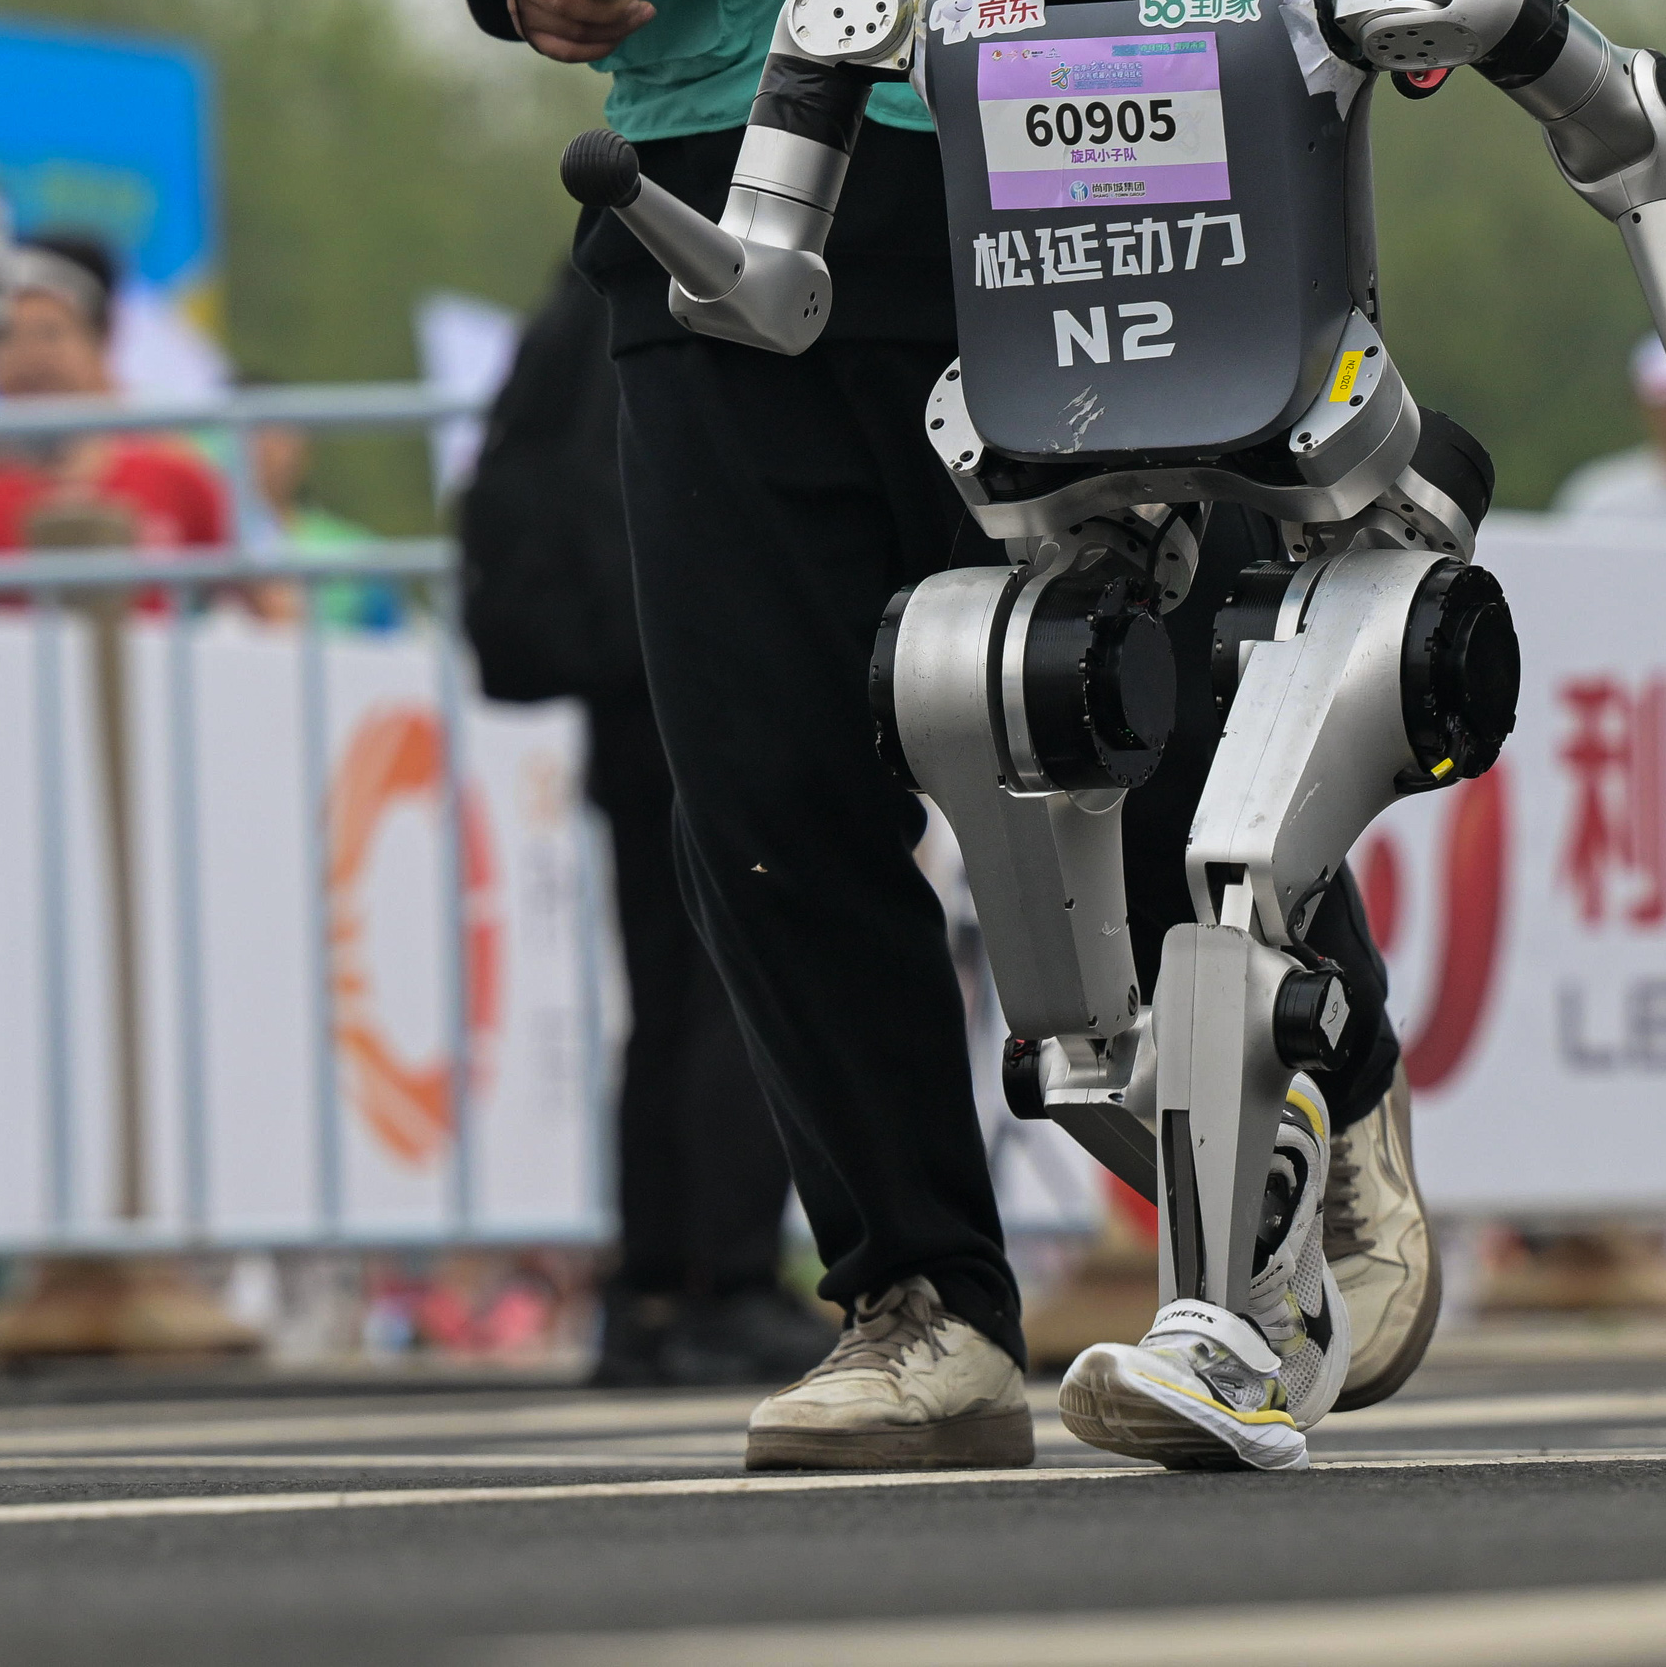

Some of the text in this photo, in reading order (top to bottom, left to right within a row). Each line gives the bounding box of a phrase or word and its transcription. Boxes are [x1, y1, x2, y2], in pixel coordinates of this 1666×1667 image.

[1025, 98, 1176, 147] 60905
[1070, 147, 1137, 163] 旋风小子队
[1092, 181, 1145, 193] 尚亦城集团
[973, 212, 1247, 290] 松延动力
[1053, 300, 1176, 367] N2
[1340, 359, 1355, 390] N2-020
